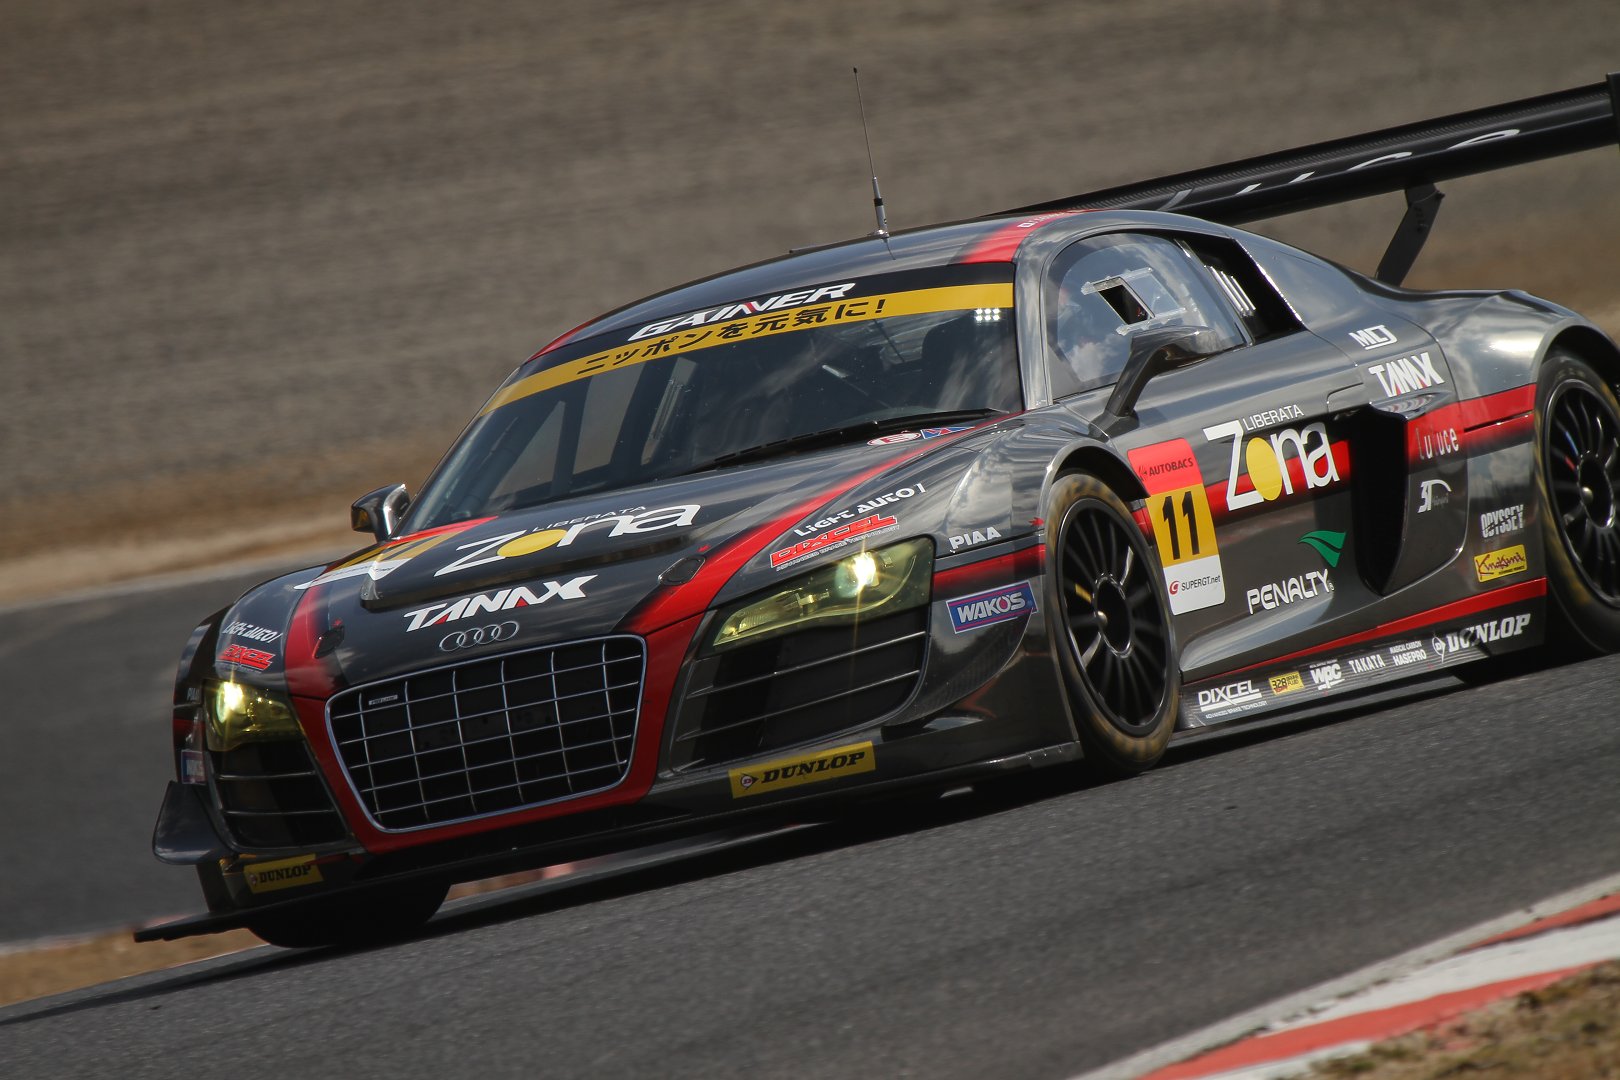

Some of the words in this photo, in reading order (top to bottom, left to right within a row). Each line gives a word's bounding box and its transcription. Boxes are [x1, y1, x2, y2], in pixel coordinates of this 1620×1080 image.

[628, 282, 856, 341] GAINER
[1368, 352, 1445, 398] TANAX
[1242, 404, 1304, 431] LIBERATA
[1149, 458, 1194, 477] AUTOBACS
[532, 506, 647, 532] LIBERATA
[1162, 490, 1200, 561] 11
[1480, 504, 1524, 538] ODYSSEY
[770, 513, 898, 568] DIXCEL
[949, 526, 1001, 551] PIAA
[1181, 574, 1221, 592] SUPERGT.net
[1247, 568, 1330, 615] PENALTY
[403, 574, 598, 633] TANAX
[1349, 654, 1386, 674] TAKATA
[1393, 648, 1427, 667] HASEPRO
[1198, 680, 1261, 708] DIXCEL
[761, 751, 865, 784] DUNLOP
[258, 863, 313, 884] DUNLOP
